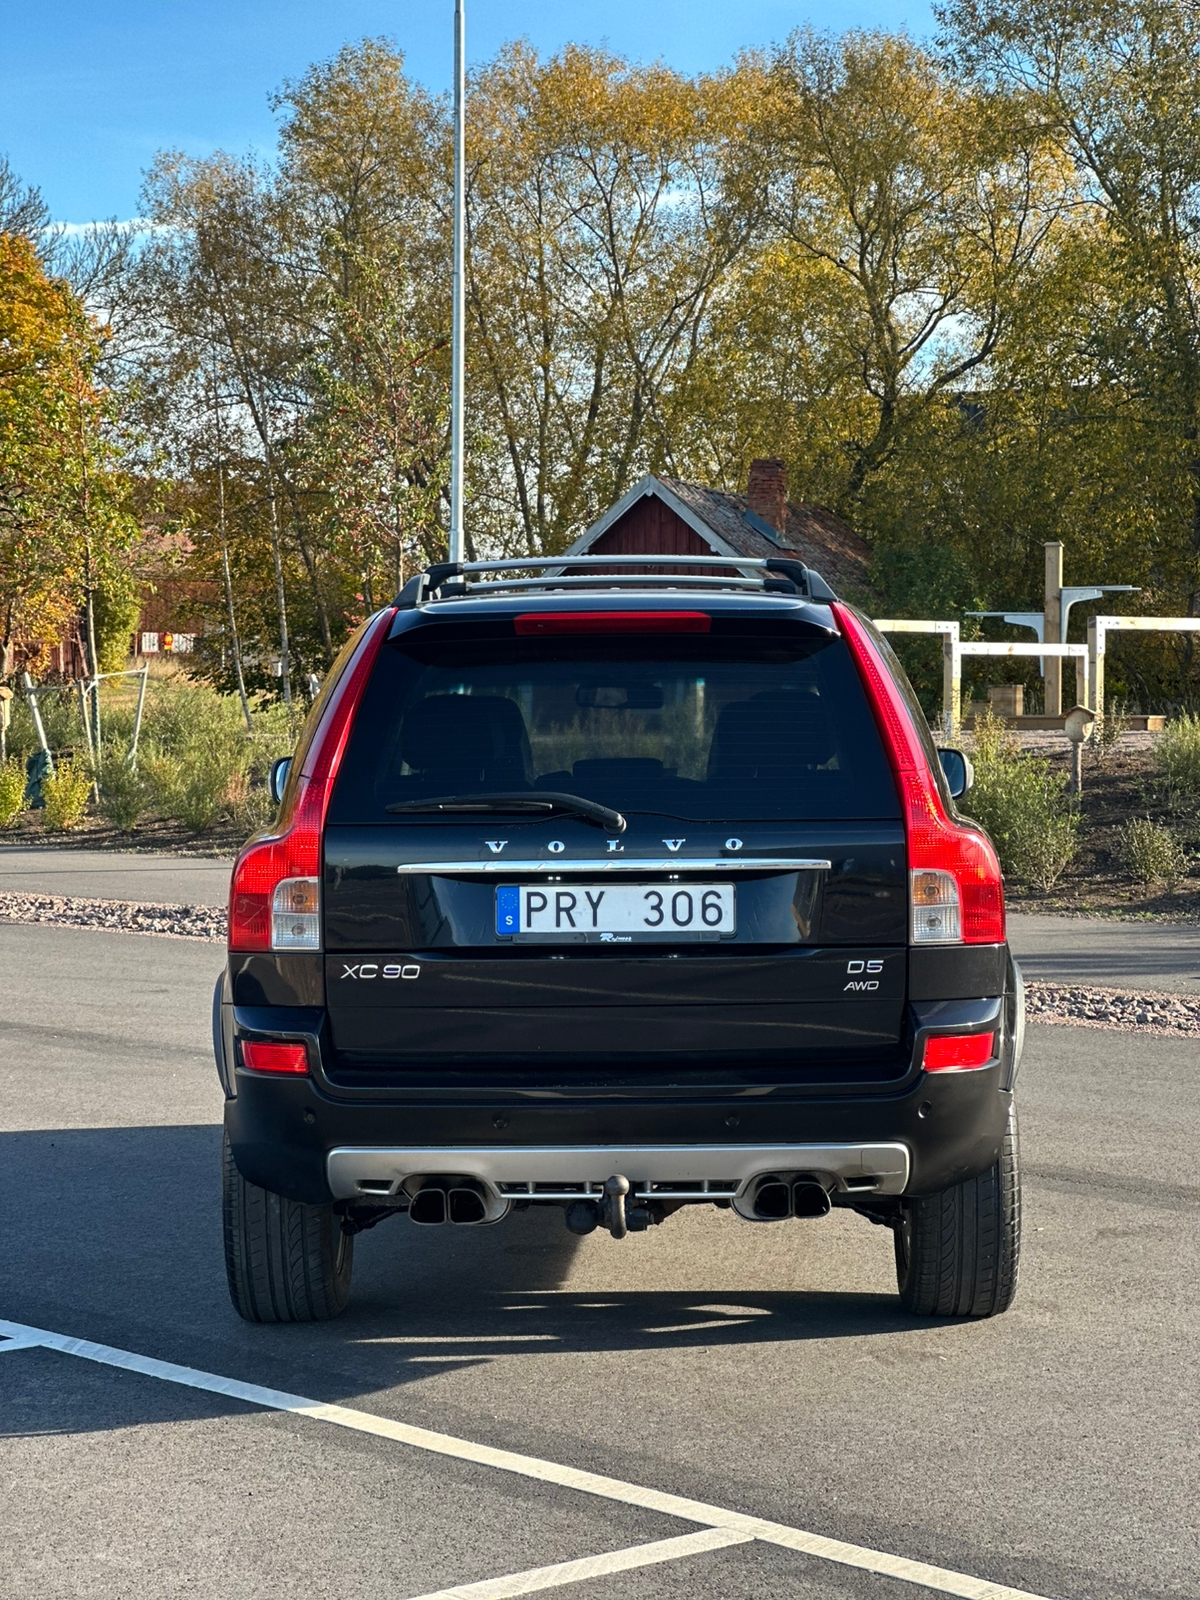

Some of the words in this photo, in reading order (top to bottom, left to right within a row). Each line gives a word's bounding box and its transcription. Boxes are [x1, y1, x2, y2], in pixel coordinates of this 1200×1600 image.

[485, 838, 743, 853] VOLVO
[526, 891, 605, 928] PRY
[643, 890, 723, 926] 306
[505, 915, 513, 926] S
[846, 960, 884, 974] D5
[843, 981, 879, 991] AWD
